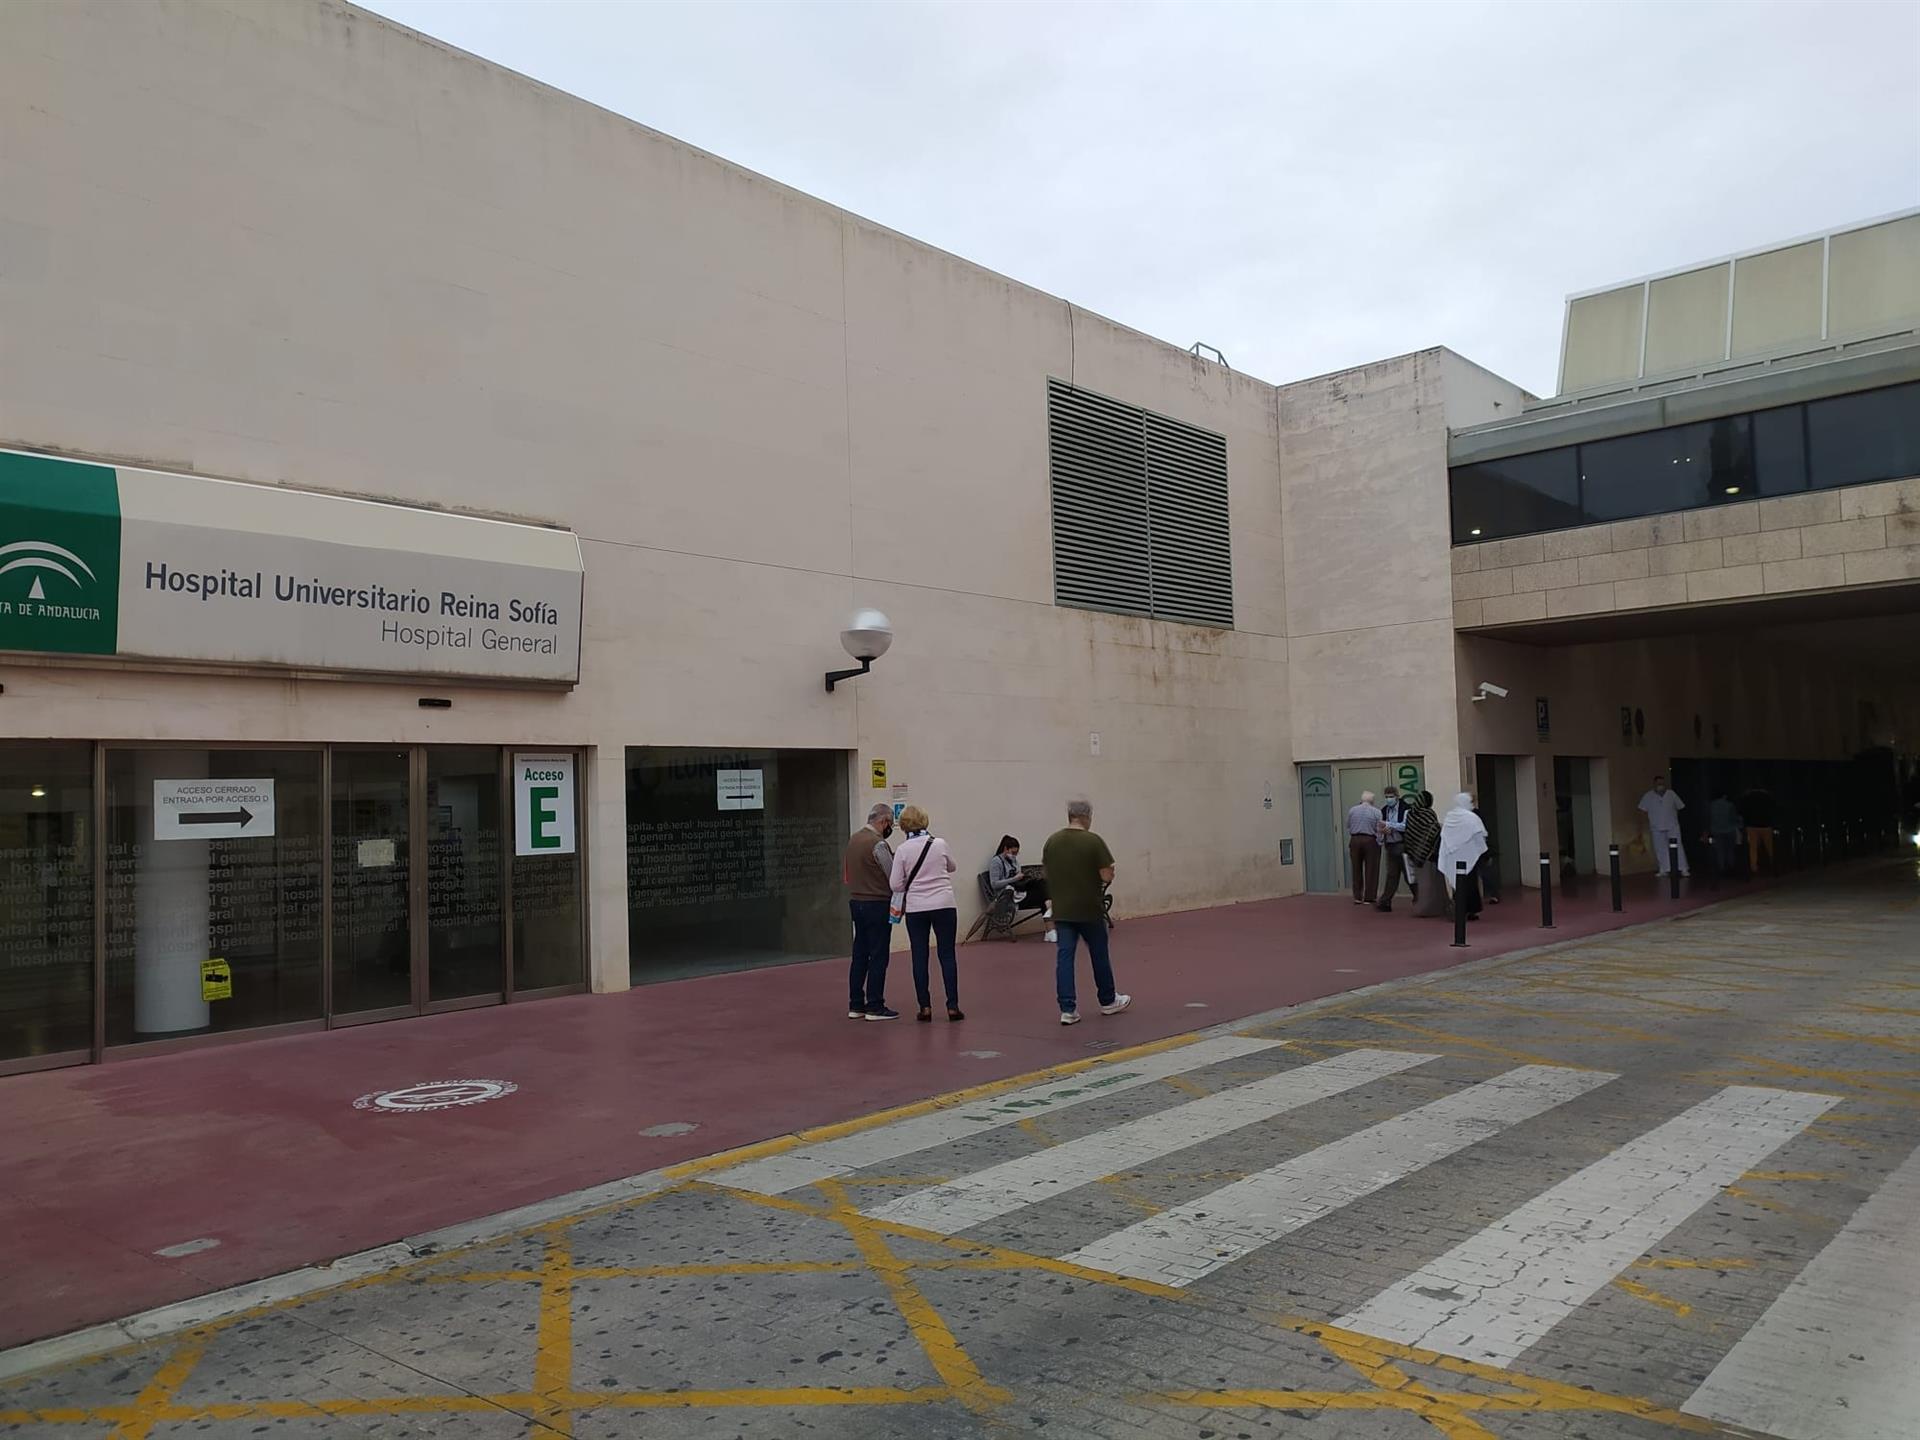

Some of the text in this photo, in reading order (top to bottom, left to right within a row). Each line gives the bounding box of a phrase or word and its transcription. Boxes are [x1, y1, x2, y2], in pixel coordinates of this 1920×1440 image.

[145, 561, 558, 625] Hospital Universitario Reina Sofía
[19, 603, 32, 616] DE
[38, 604, 100, 621] ANDALUCIA
[381, 620, 557, 655] Hospital General
[524, 767, 564, 781] Acceso
[176, 785, 257, 795] ACCESO CERRADO
[162, 796, 205, 805] ENTRADA
[206, 796, 224, 804] POR
[226, 795, 261, 804] ACCESO
[530, 787, 561, 849] E
